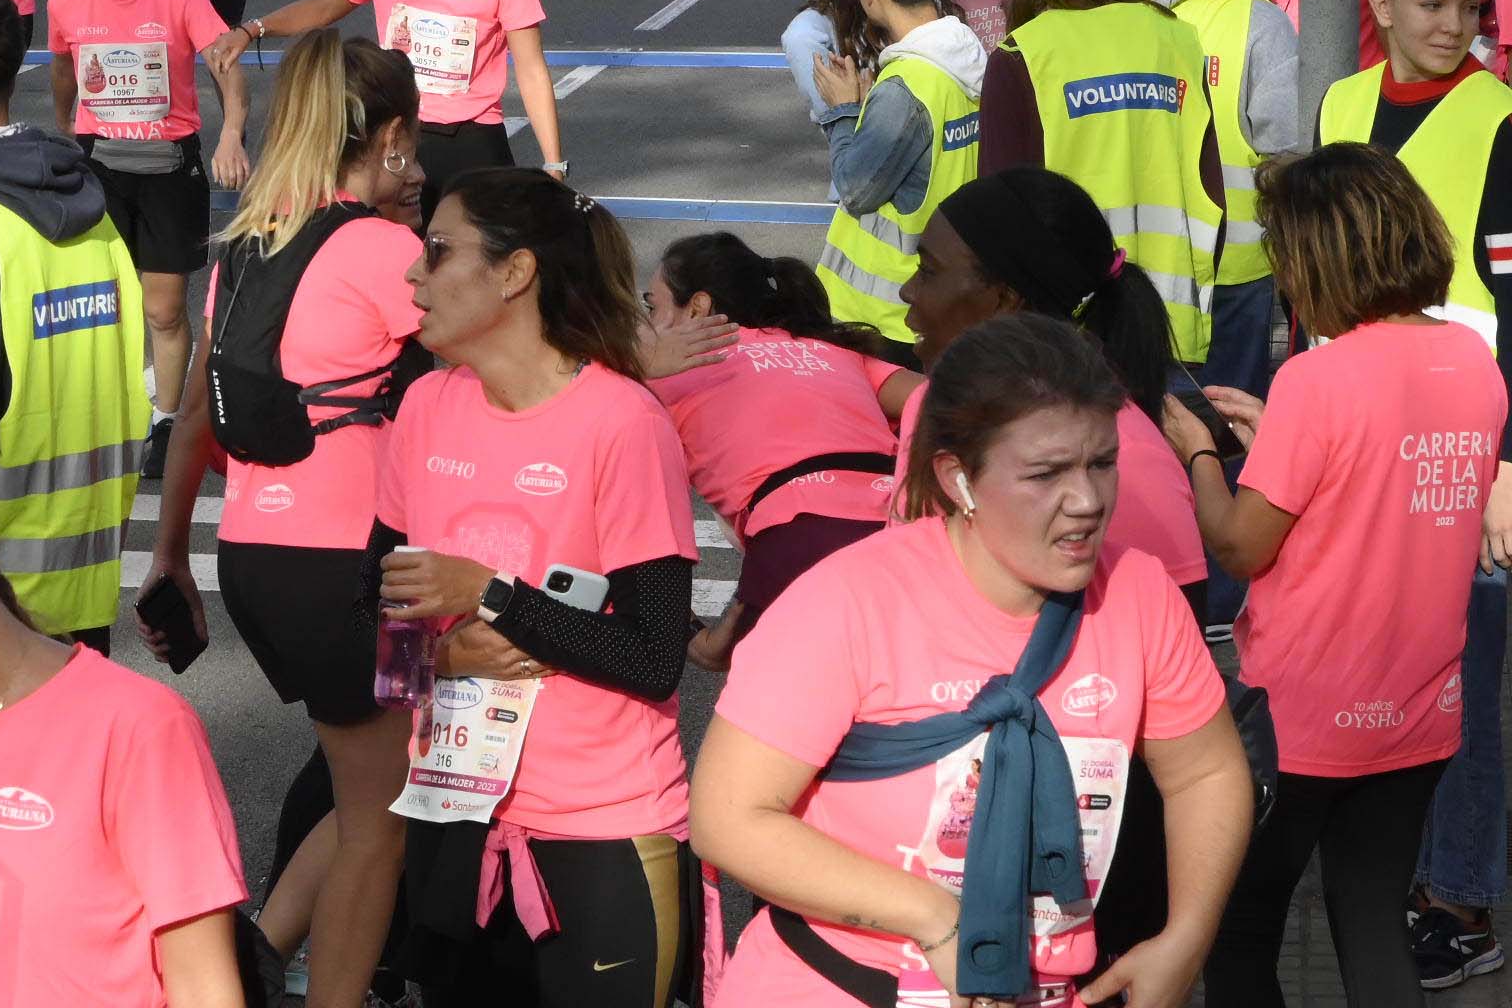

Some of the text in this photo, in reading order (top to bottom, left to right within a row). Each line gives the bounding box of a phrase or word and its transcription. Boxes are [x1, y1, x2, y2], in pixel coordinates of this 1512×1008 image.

[414, 42, 442, 57] 016
[107, 55, 138, 64] ASTURIANA
[108, 74, 138, 86] 016
[1068, 82, 1177, 110] VOLUNTARIS
[746, 349, 781, 359] DE
[752, 357, 835, 373] MUJER
[213, 369, 226, 424] EVADICT
[1399, 431, 1492, 461] CARRERA
[1416, 458, 1477, 486] DE LA
[1409, 486, 1479, 513] MUJER
[1435, 516, 1455, 527] 2023
[490, 686, 523, 700] SUMA
[1354, 700, 1394, 712] 10 AÑOS
[1335, 709, 1404, 729] OYSHO
[433, 722, 469, 748] 016
[435, 753, 452, 768] 316
[1079, 767, 1114, 779] SUMA
[438, 776, 447, 785] LA
[448, 776, 475, 789] MUJER
[476, 781, 496, 792] 2023
